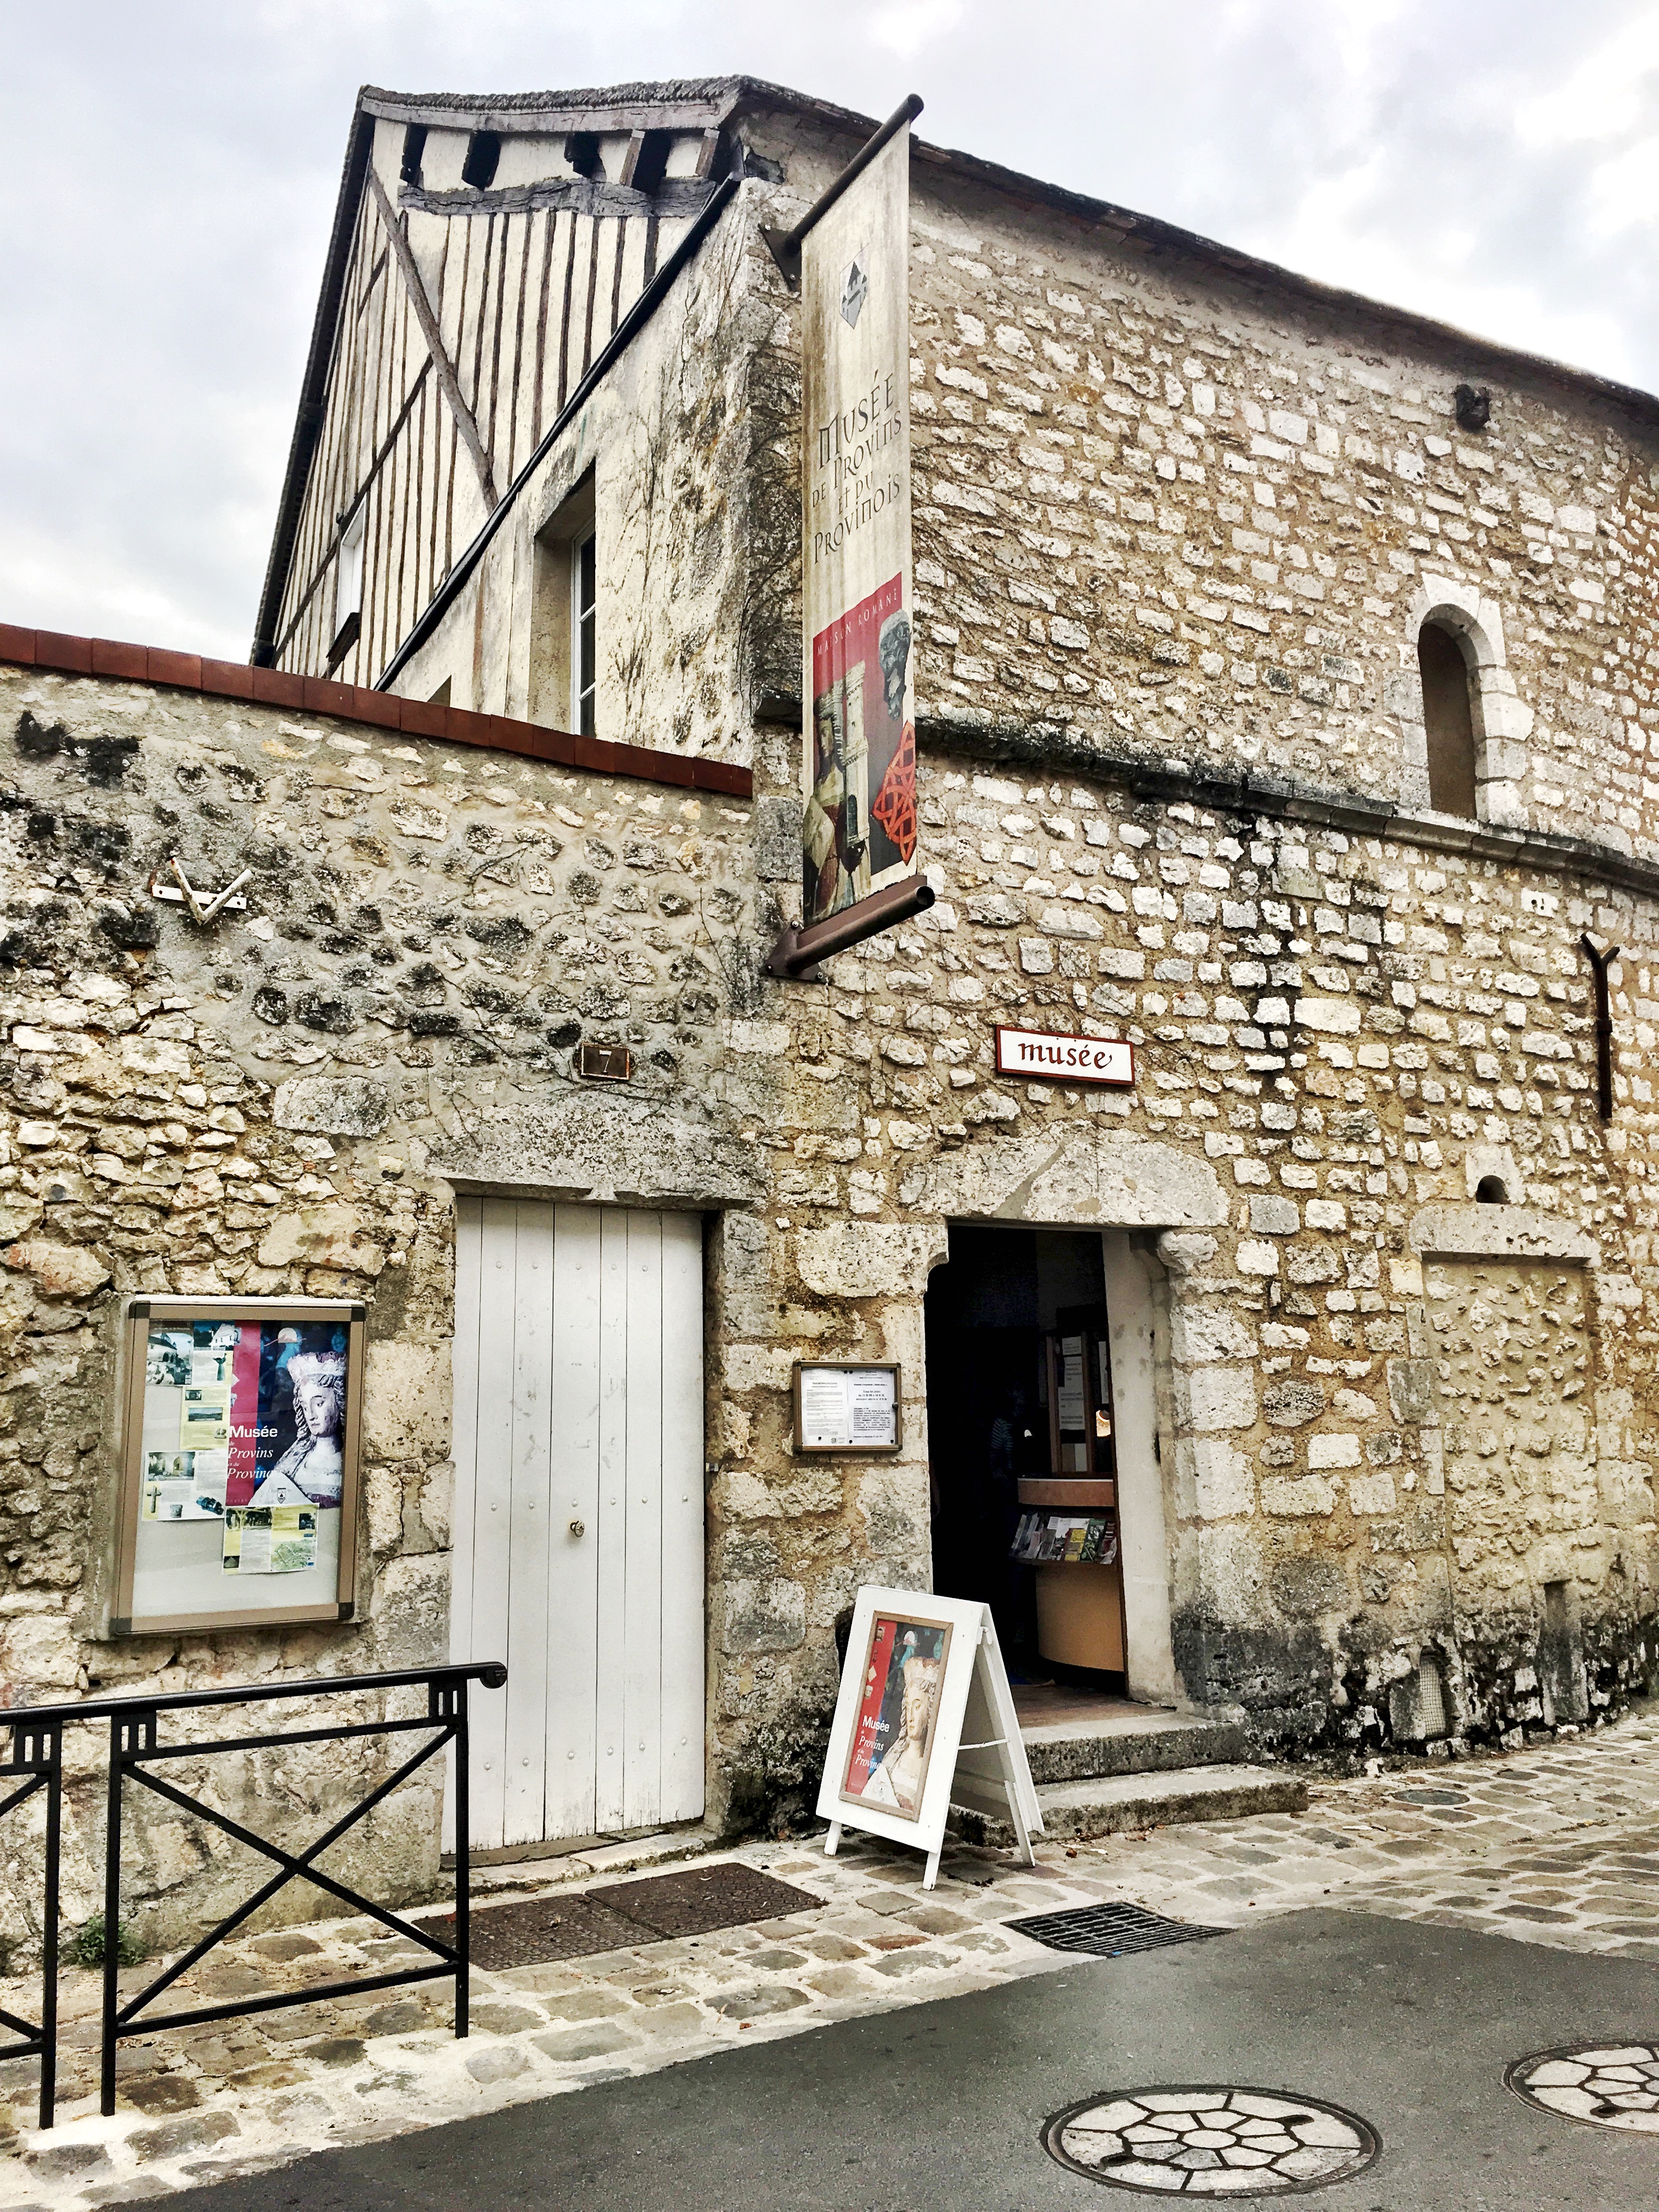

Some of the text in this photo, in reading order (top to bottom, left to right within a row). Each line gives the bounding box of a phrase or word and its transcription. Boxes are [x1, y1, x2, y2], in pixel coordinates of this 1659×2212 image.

[819, 369, 894, 471] MUSÉE
[812, 483, 826, 509] DE
[817, 588, 897, 656] MAISON ROMANE
[599, 1049, 612, 1074] 7
[1018, 1044, 1113, 1069] musée
[229, 1425, 278, 1438] Musée
[228, 1447, 274, 1459] Provins
[862, 1715, 890, 1733] Musée
[859, 1735, 884, 1751] Provins
